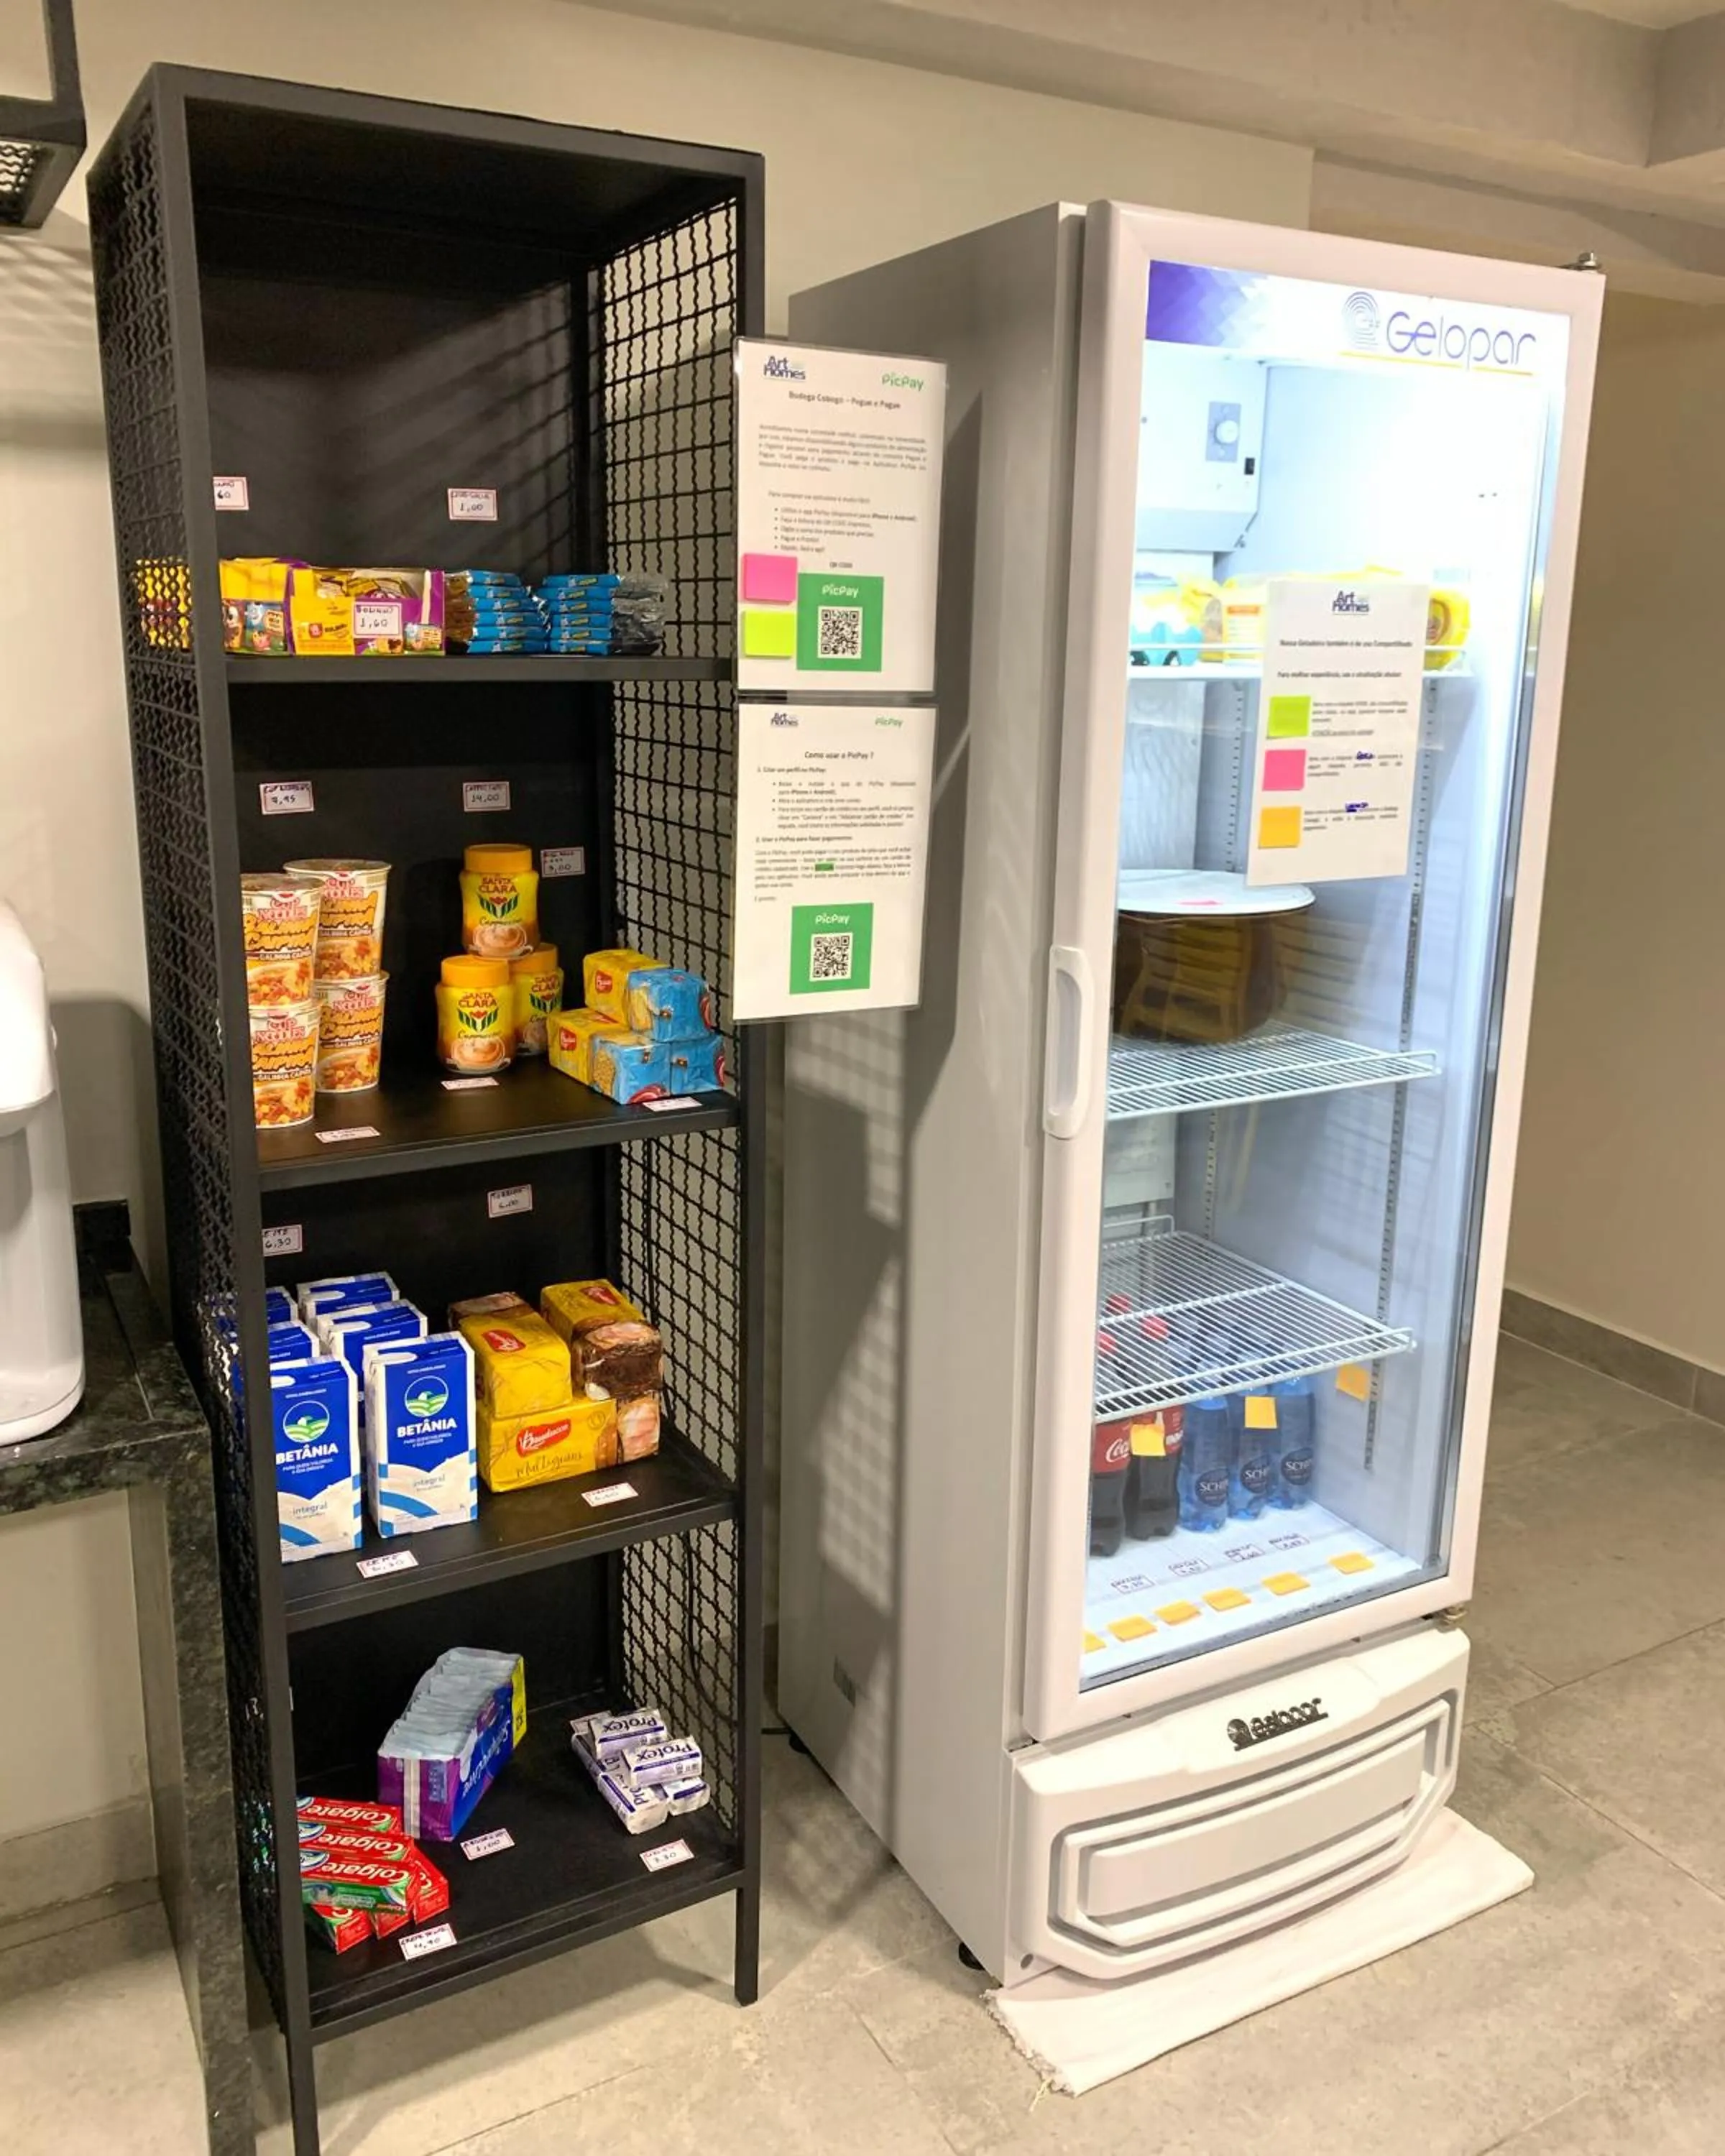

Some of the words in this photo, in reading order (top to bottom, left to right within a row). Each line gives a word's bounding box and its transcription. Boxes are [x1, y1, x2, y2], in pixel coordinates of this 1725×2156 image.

[1386, 310, 1537, 371] Gelopar
[767, 355, 788, 369] Art
[763, 364, 806, 380] Homes
[881, 372, 924, 392] PicPay
[822, 583, 860, 598] PicPay
[1335, 590, 1355, 604] Art
[1332, 600, 1370, 612] Homes
[875, 717, 903, 728] PicPay
[847, 752, 868, 760] PicPay
[478, 884, 518, 893] CLARA
[815, 913, 850, 925] PicPay
[458, 999, 498, 1008] CLARA
[463, 991, 494, 1000] SANTA
[397, 1417, 458, 1438] BETÂNIA
[275, 1442, 339, 1465] BETÂNIA
[293, 1500, 328, 1516] integral
[602, 1716, 658, 1733] Protex
[1250, 1697, 1324, 1740] Gelopar
[637, 1743, 694, 1761] Protex
[306, 1804, 392, 1825] Colgate
[318, 1832, 405, 1855] Colgate
[321, 1861, 410, 1884] Colgate
